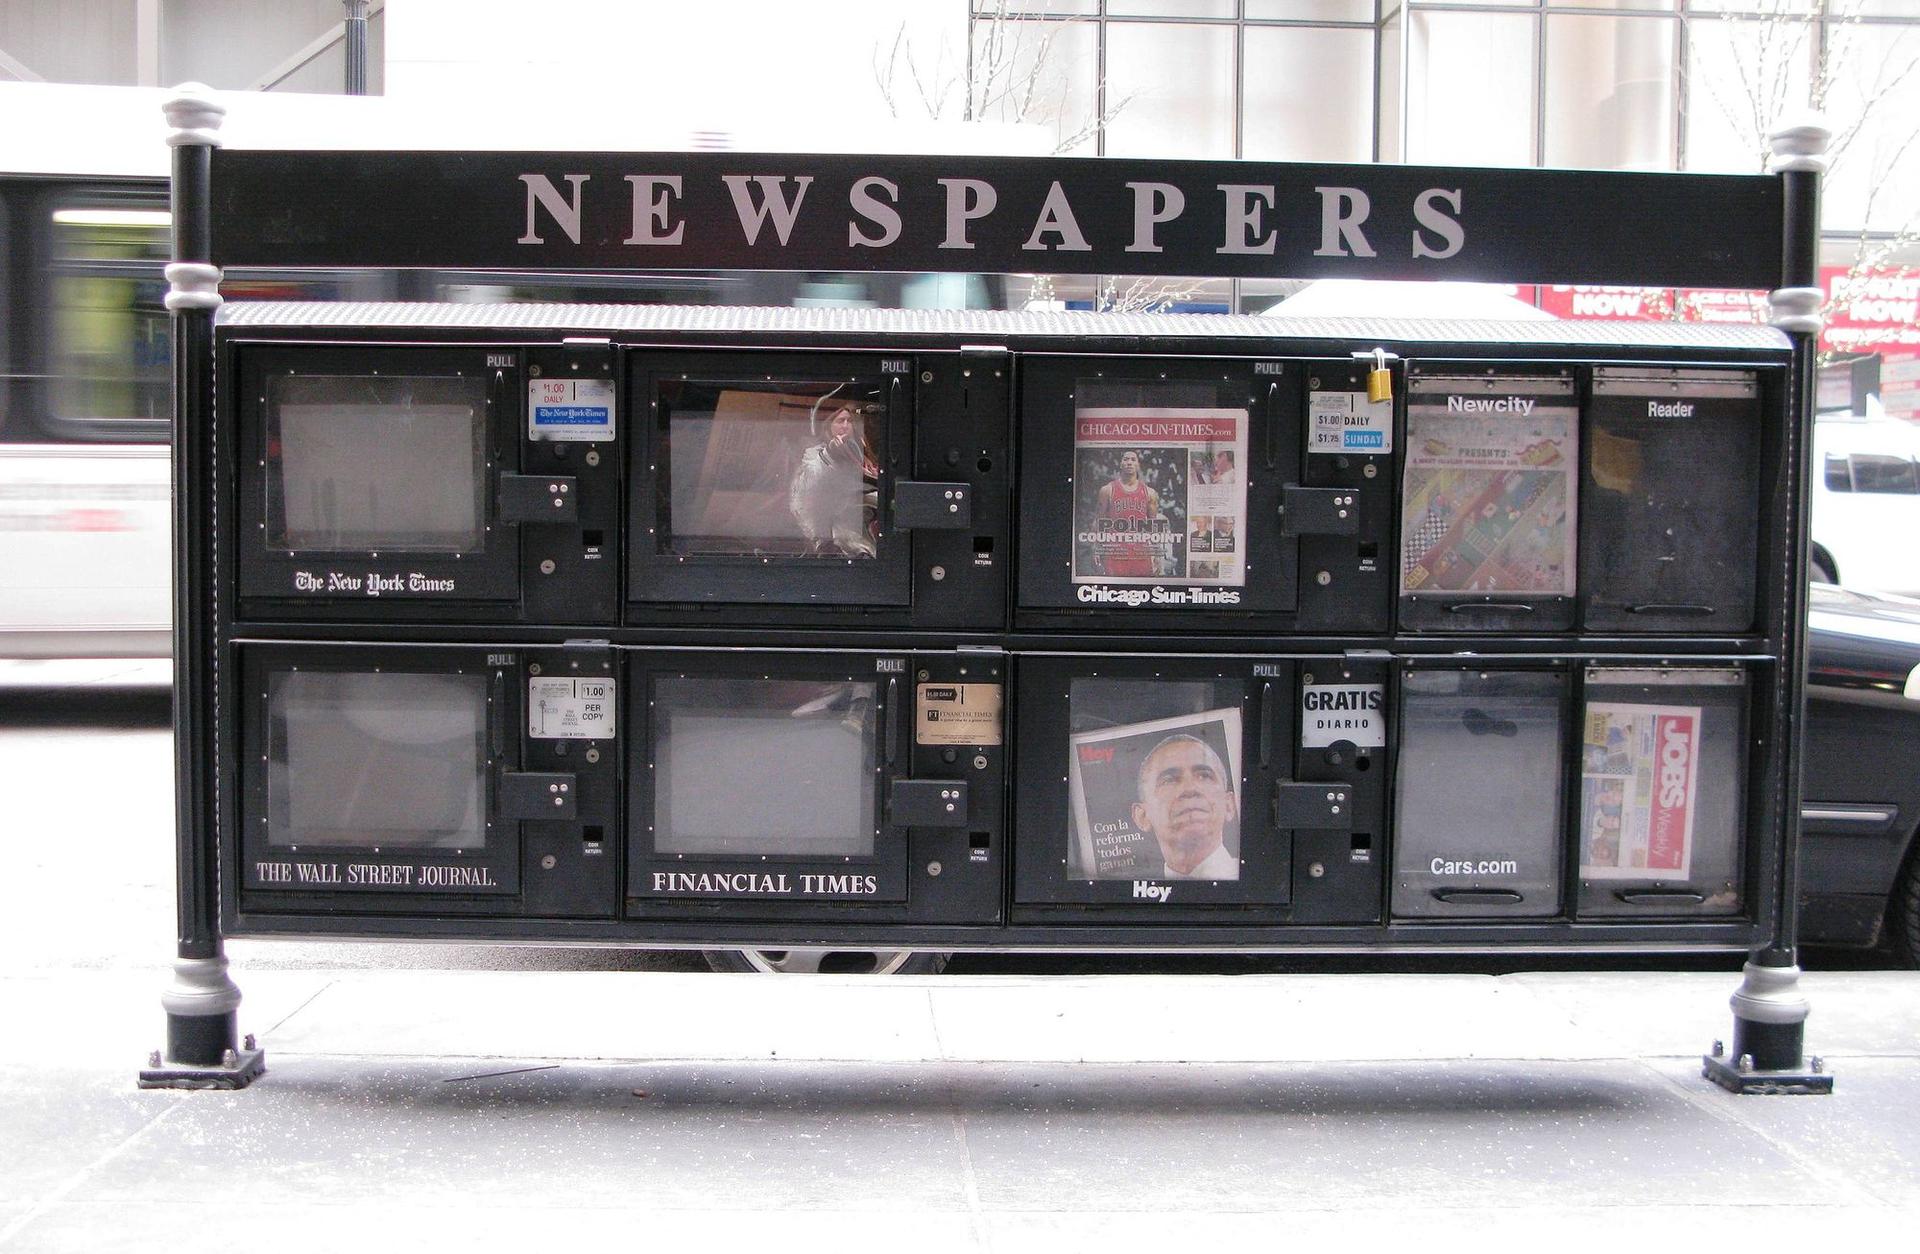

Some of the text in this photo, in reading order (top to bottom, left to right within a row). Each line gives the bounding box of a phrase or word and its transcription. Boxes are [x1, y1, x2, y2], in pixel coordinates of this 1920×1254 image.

[517, 174, 1465, 259] NEWSPAPERS
[1573, 293, 1640, 316] NOW
[1849, 300, 1917, 323] NOW
[487, 354, 515, 367] PULL
[881, 360, 909, 372] PULL
[1254, 363, 1282, 374] PULL
[544, 383, 565, 393] $1.00
[540, 408, 553, 417] The
[584, 408, 606, 417] Times
[1447, 396, 1534, 416] Newcity
[1648, 401, 1695, 417] Reader
[1318, 415, 1370, 426] $1.00 DAILY
[1081, 423, 1139, 436] CHICAGO
[1318, 433, 1382, 444] $1.75 SUNDAY
[1079, 532, 1183, 543] COUNTERPOINT
[295, 571, 455, 597] The New York Times
[1077, 585, 1241, 606] Chicago Sun-Times
[487, 654, 515, 665] PULL
[876, 659, 904, 671] PULL
[1253, 665, 1280, 676] PULL
[1304, 691, 1381, 711] GRATIS
[585, 704, 601, 712] PER
[1317, 719, 1369, 728] DIARIO
[1659, 719, 1689, 808] JOBS
[1094, 822, 1117, 833] Con
[1430, 857, 1517, 875] Cars.com
[257, 862, 497, 886] THE WALL STREET JOURNAL.
[652, 872, 877, 894] FINANCIAL TIMES
[1133, 880, 1172, 903] Hoy
